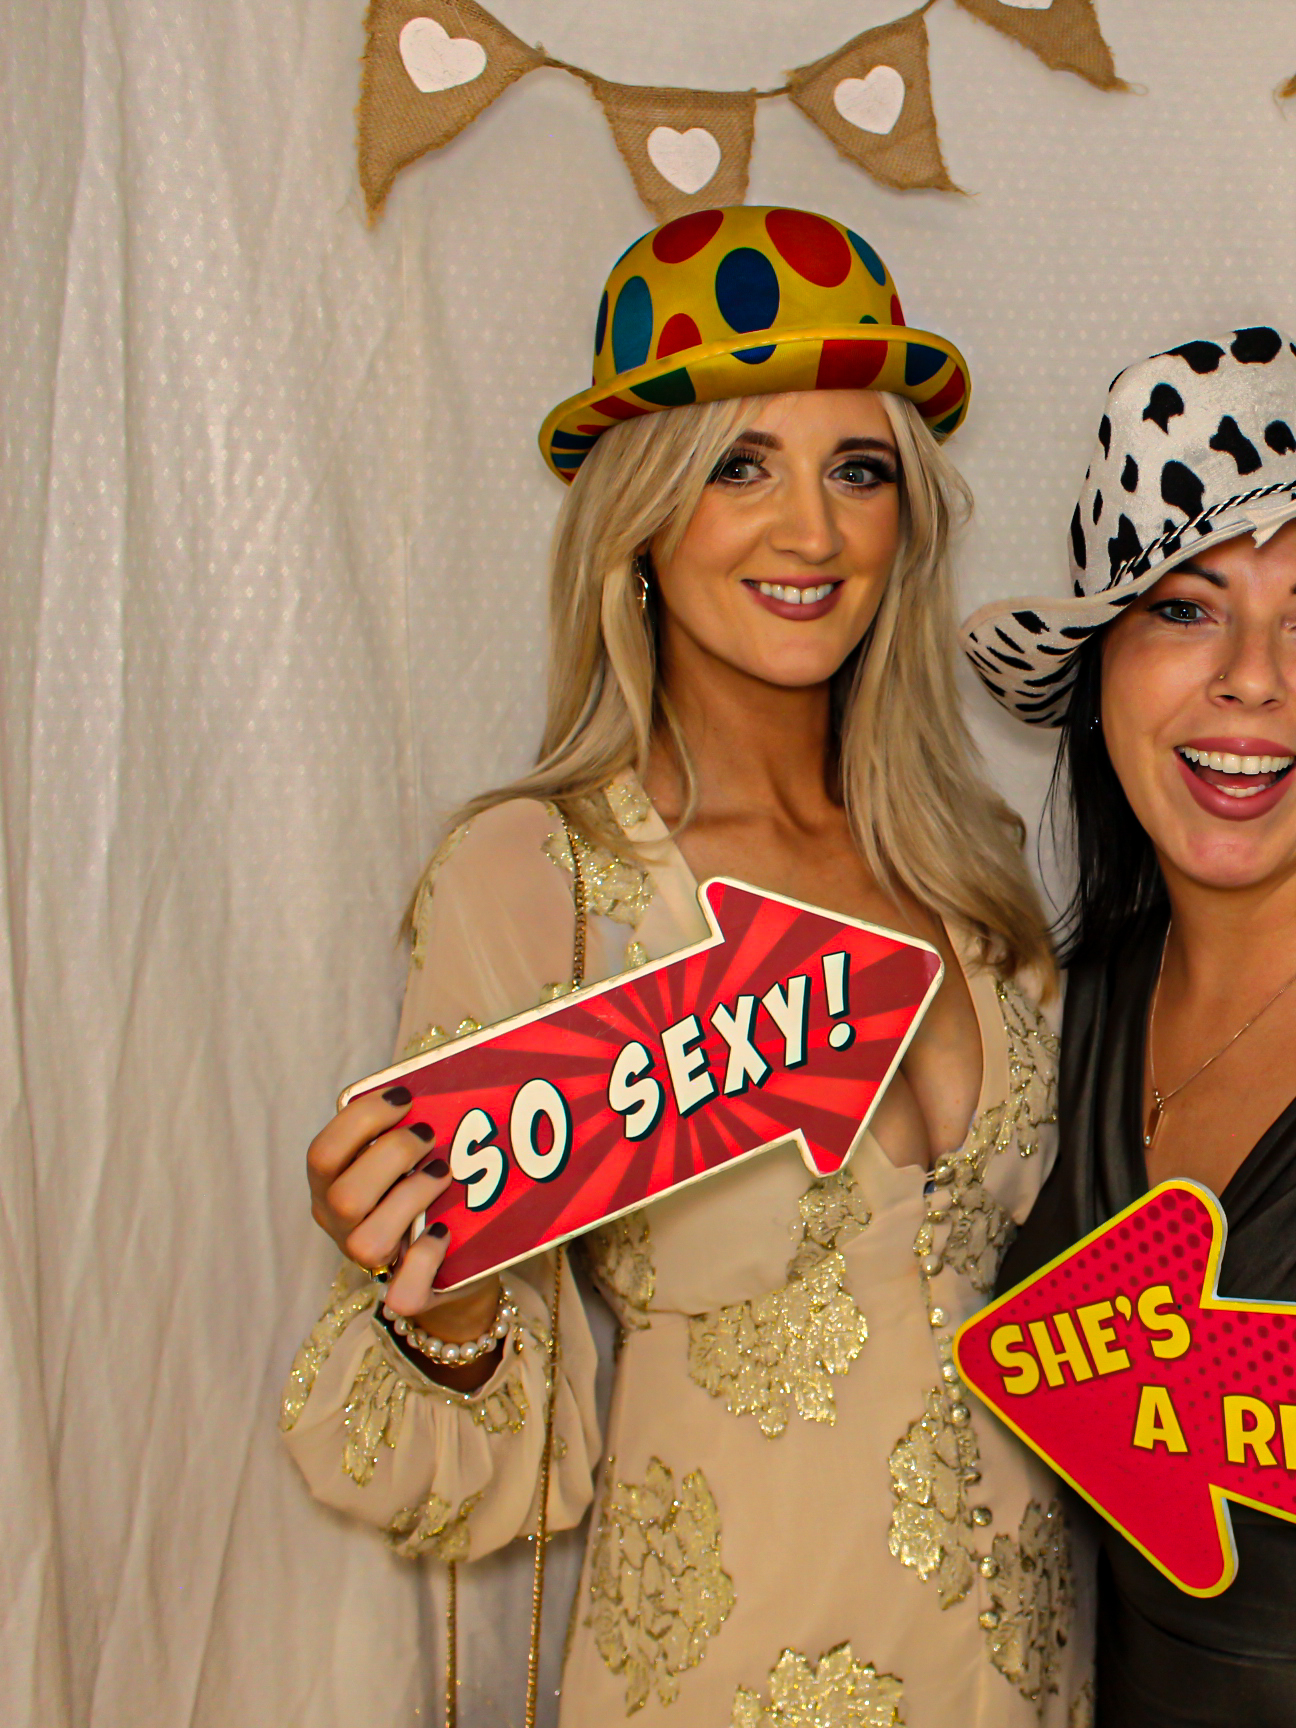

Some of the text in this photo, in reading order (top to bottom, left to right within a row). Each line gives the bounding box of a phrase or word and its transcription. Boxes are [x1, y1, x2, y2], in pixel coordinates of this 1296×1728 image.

[449, 950, 857, 1210] SO SEXY!
[990, 1285, 1192, 1396] SHE'S
[1132, 1385, 1189, 1453] A
